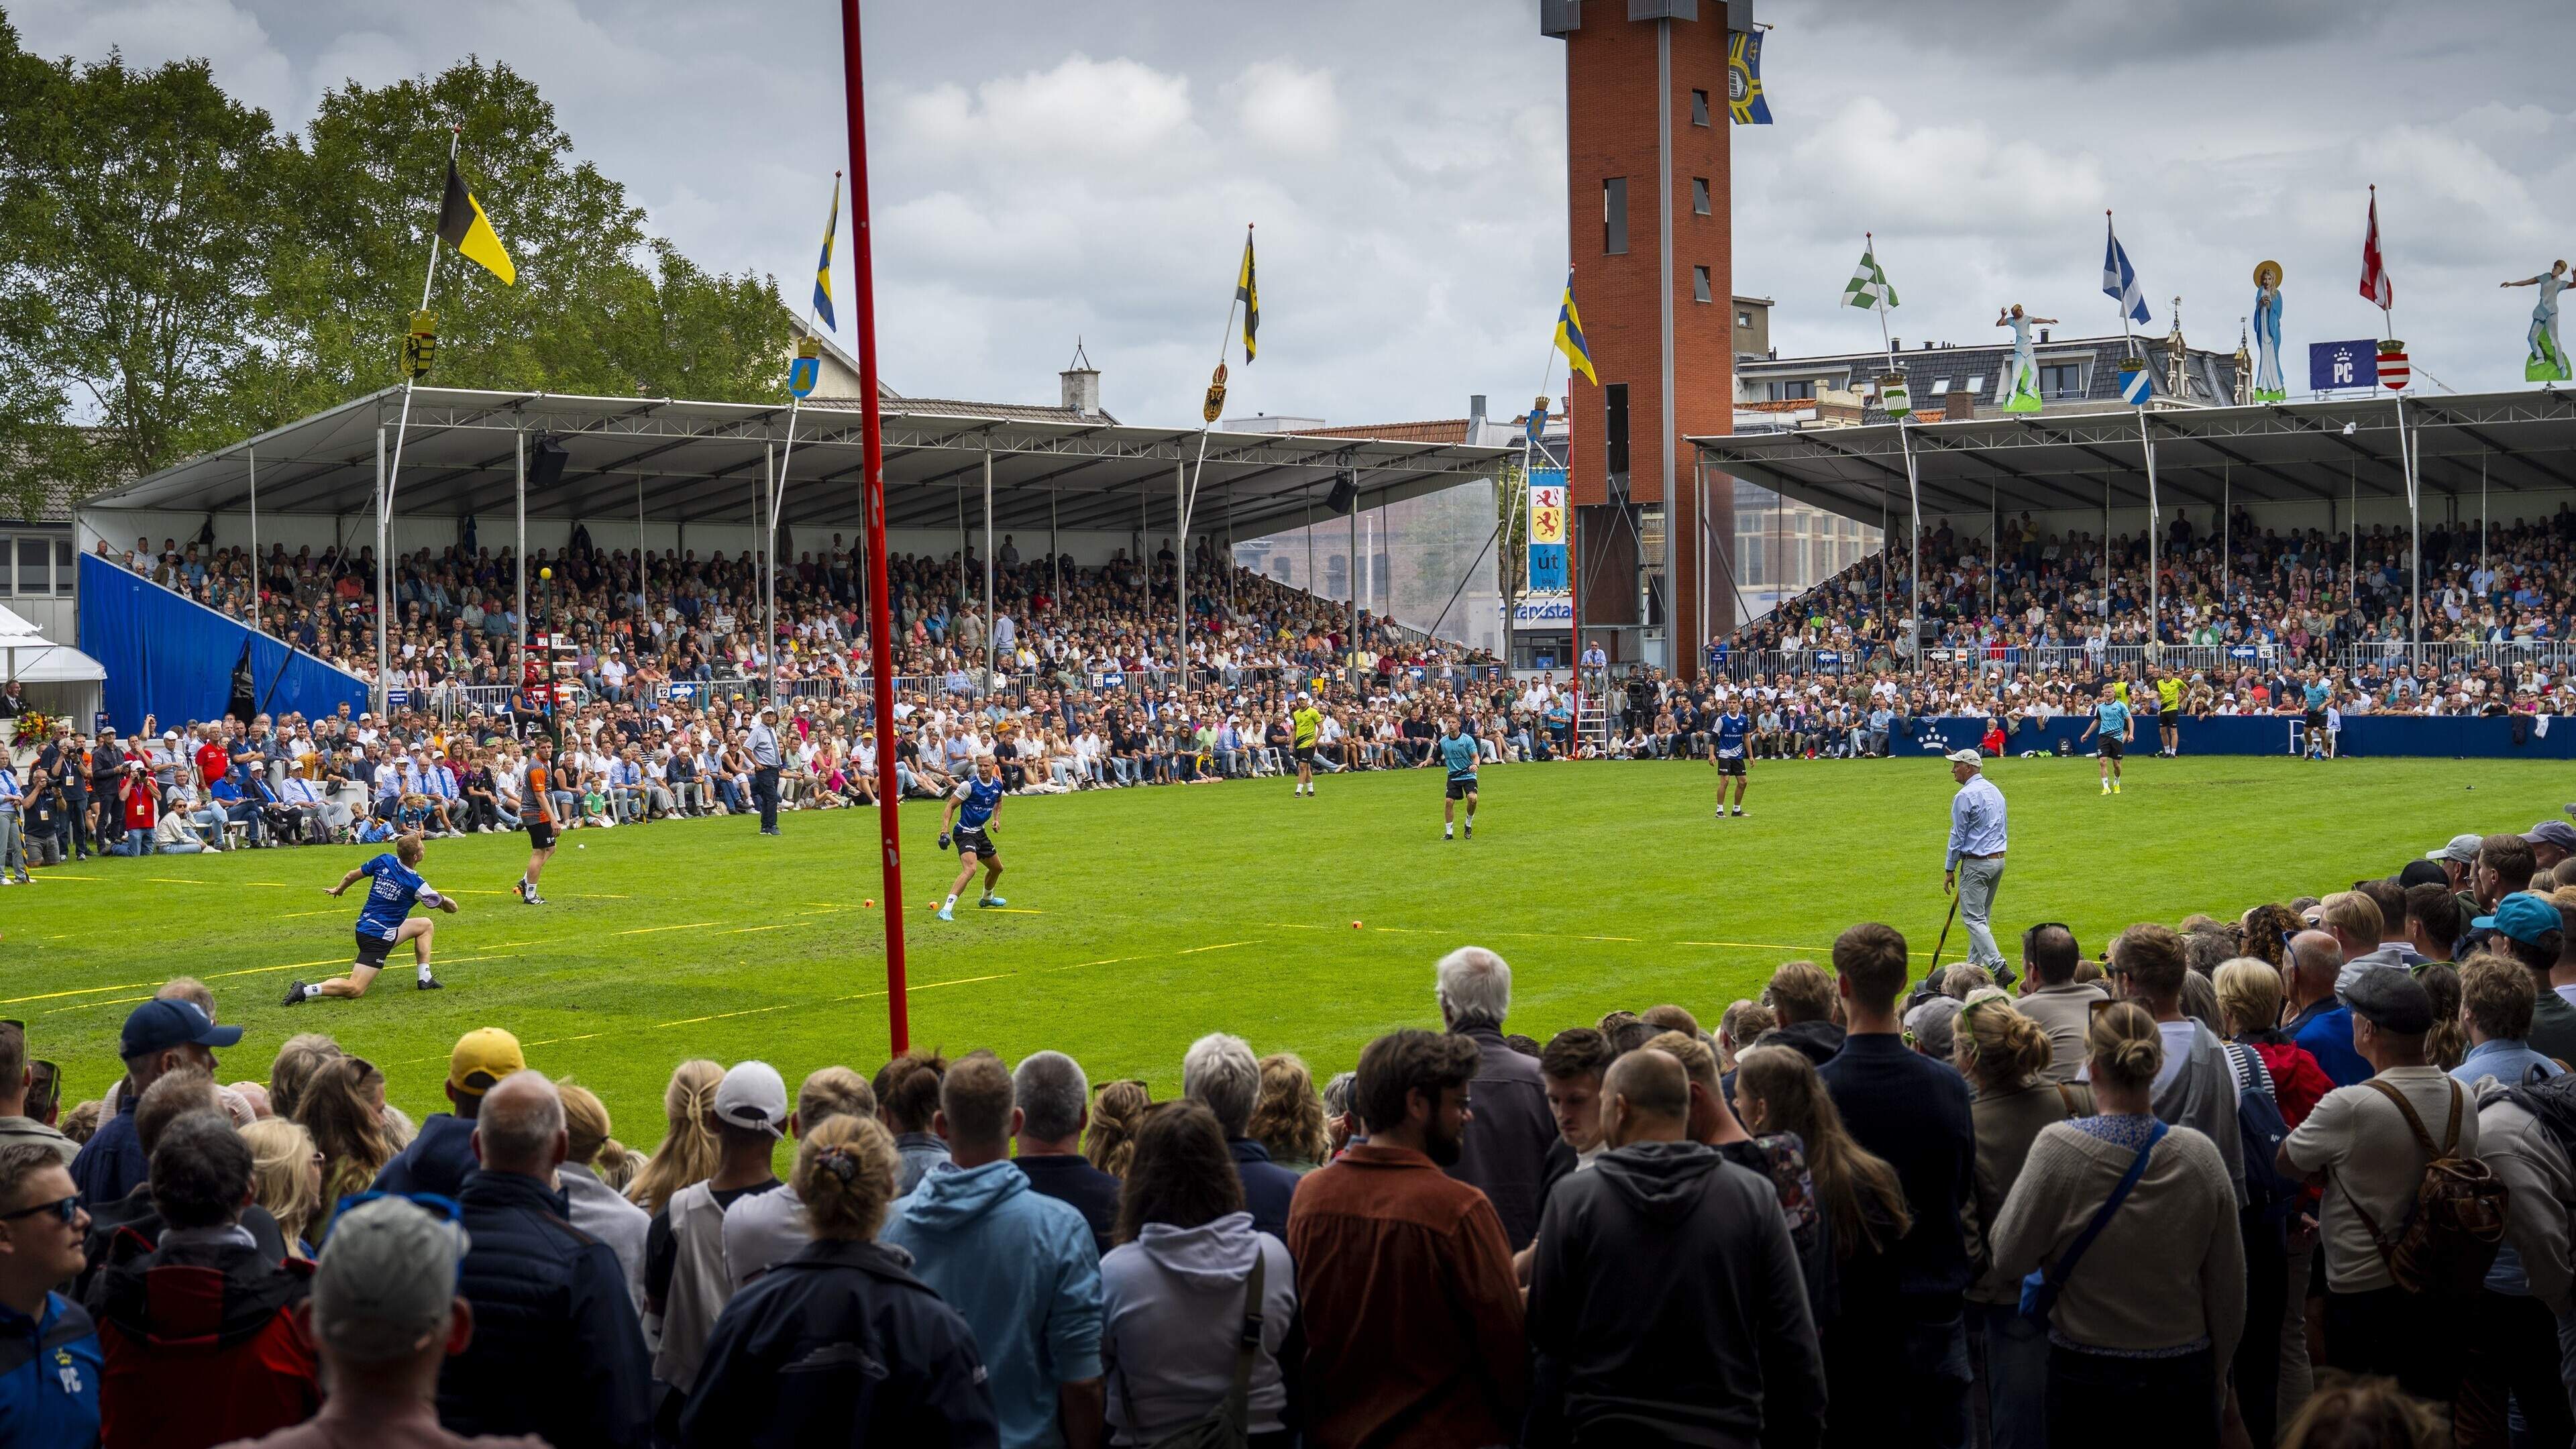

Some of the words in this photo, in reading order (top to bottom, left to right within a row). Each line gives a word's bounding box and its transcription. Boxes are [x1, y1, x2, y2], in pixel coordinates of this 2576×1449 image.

[2334, 362, 2353, 383] PC
[1538, 549, 1558, 570] út
[659, 689, 668, 697] 12
[58, 1367, 82, 1393] PC
